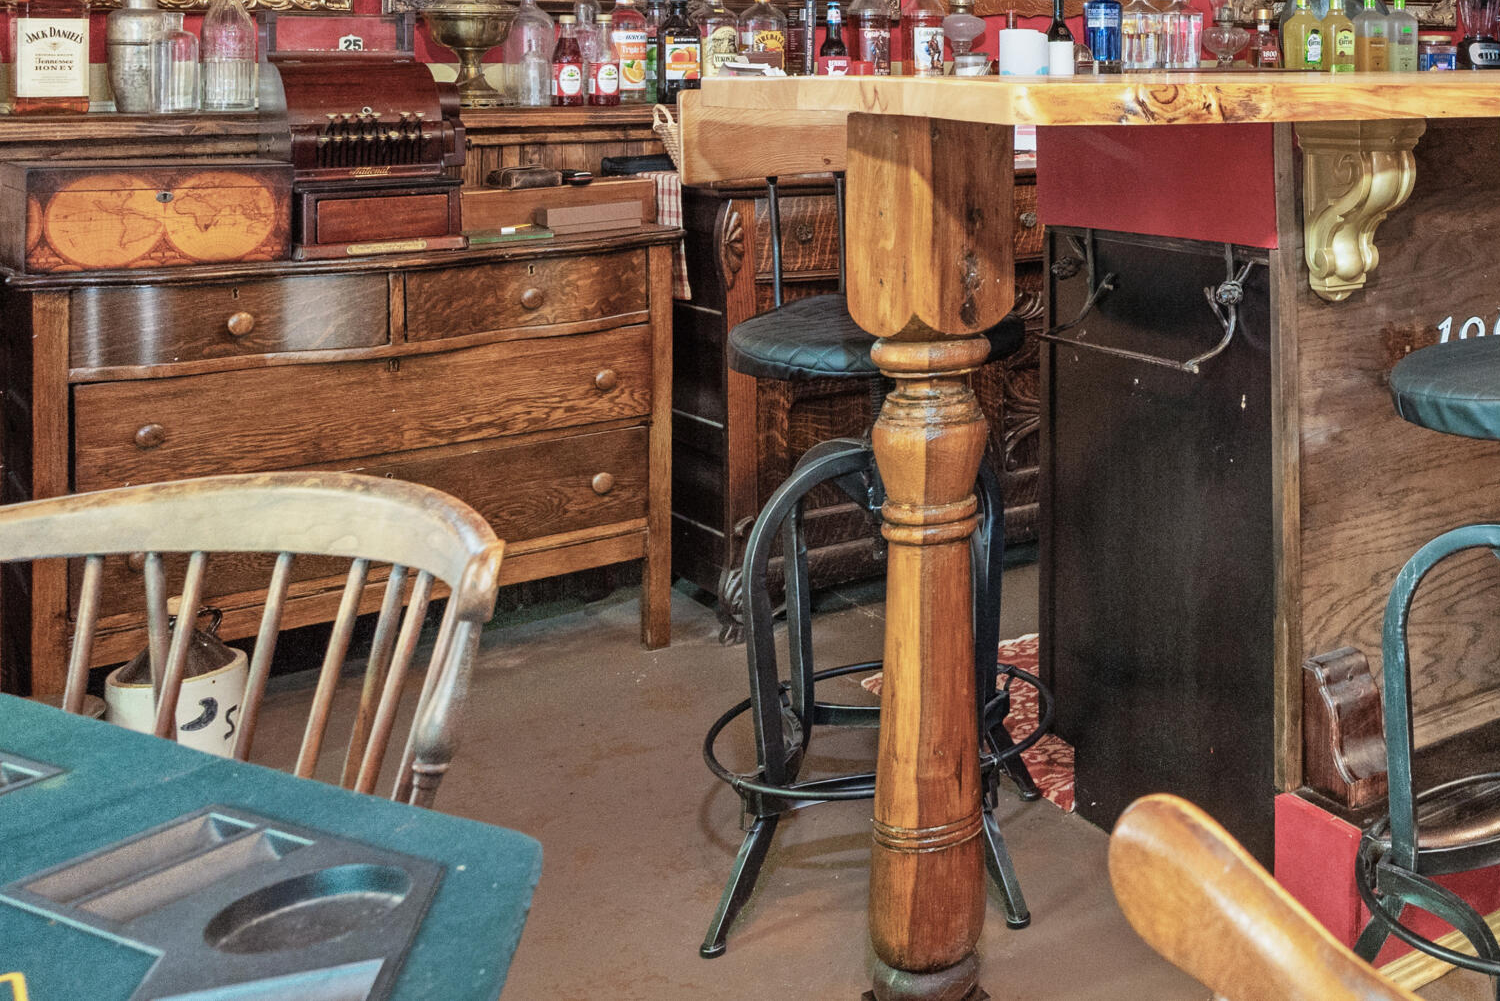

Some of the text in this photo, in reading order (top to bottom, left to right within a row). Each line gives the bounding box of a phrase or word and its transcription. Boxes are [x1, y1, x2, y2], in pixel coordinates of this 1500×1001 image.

[25, 26, 83, 45] JACK DANIEL'S
[343, 39, 362, 50] 25
[1262, 50, 1278, 58] 1800
